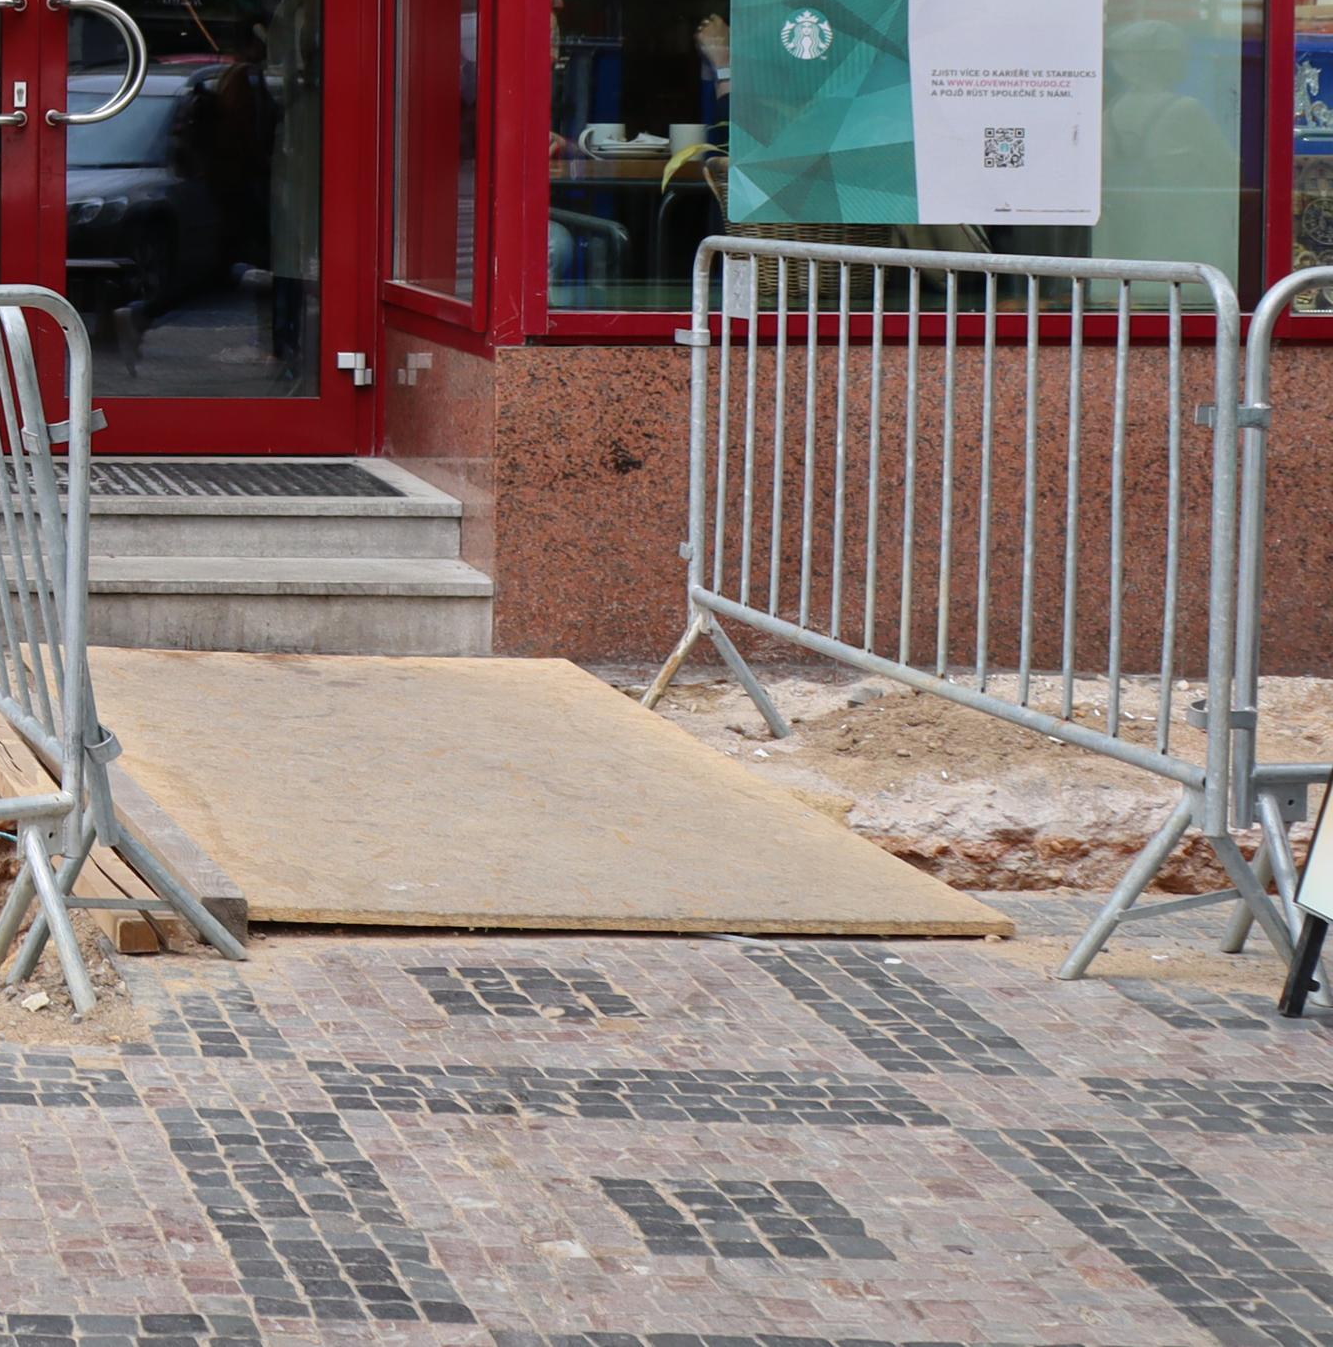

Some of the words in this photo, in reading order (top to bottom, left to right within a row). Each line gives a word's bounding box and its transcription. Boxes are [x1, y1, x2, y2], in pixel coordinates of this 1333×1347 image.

[960, 68, 980, 77] VÍCE
[1045, 70, 1096, 78] STARBUCKS
[991, 89, 1036, 97] SPOLEČNĚ
